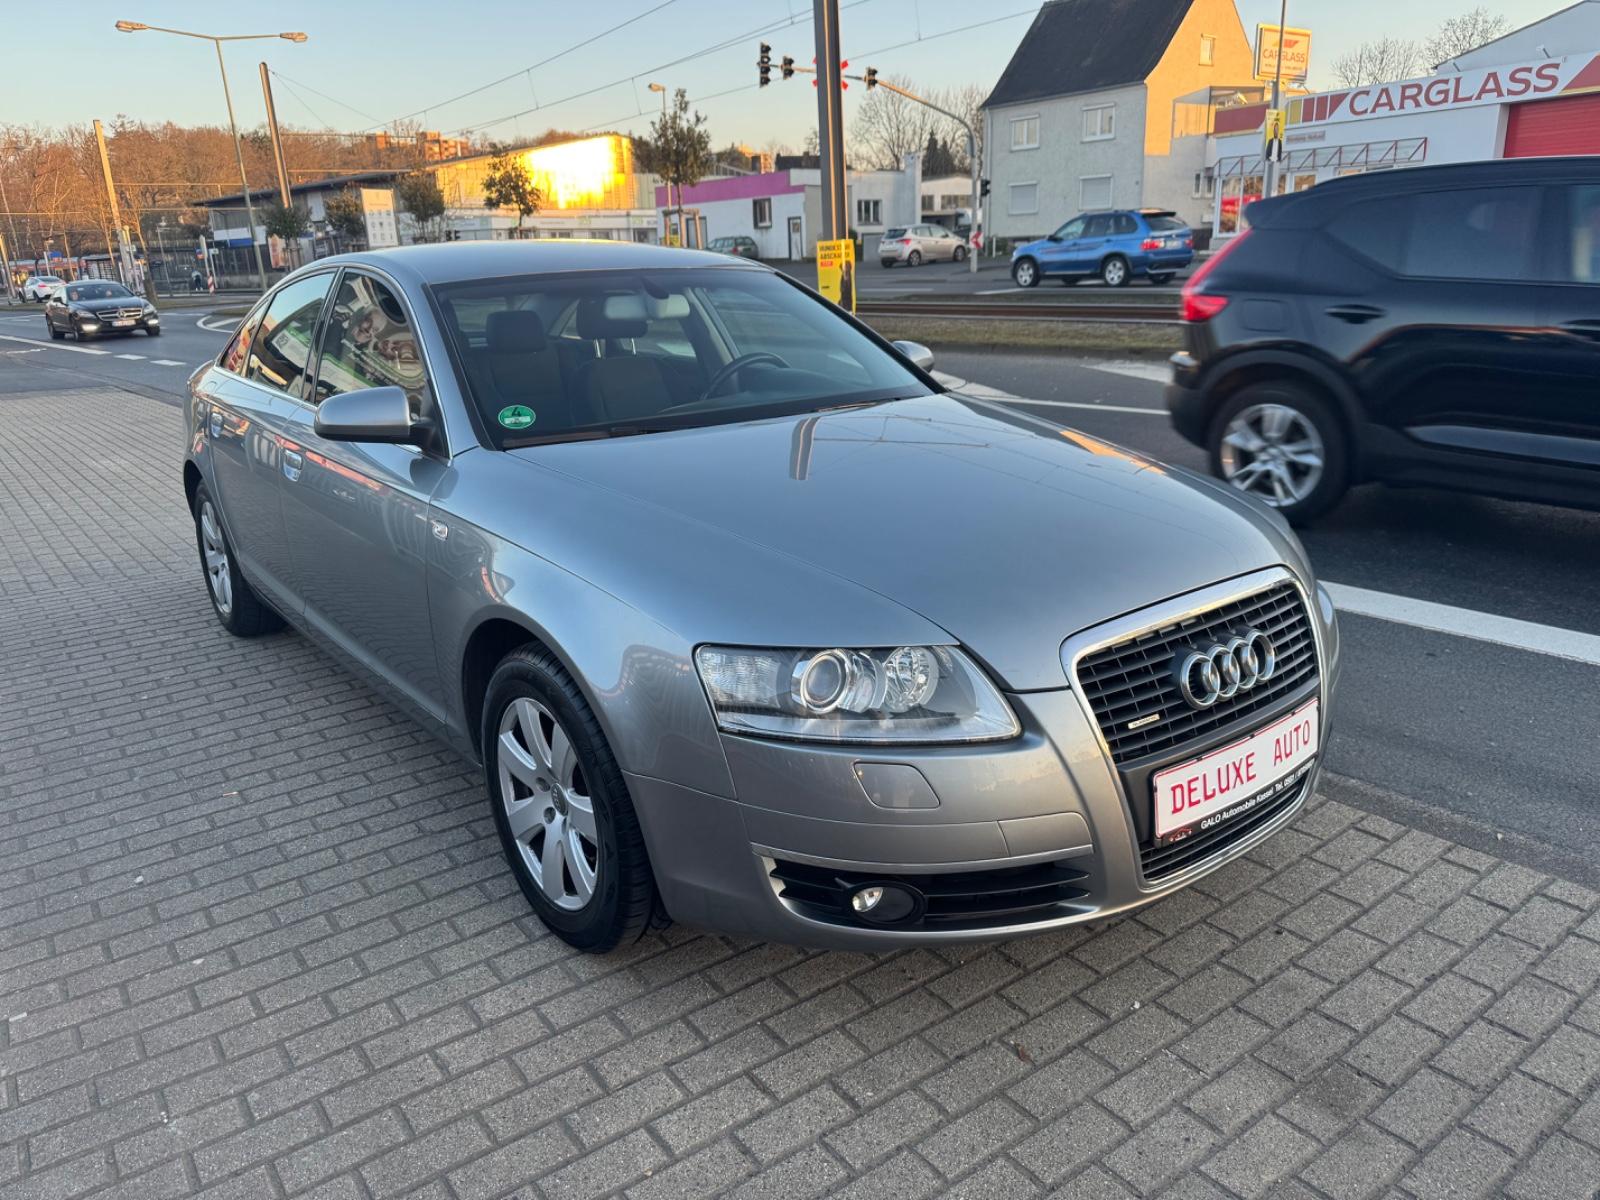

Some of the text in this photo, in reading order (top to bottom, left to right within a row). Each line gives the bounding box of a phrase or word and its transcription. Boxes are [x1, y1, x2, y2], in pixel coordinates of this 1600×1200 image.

[1263, 48, 1305, 63] CARGLASS
[1349, 63, 1561, 116] CARGLASS
[1171, 719, 1311, 814] DELUXE AUTO
[1200, 815, 1221, 829] GALO
[1221, 799, 1256, 819] Automobile
